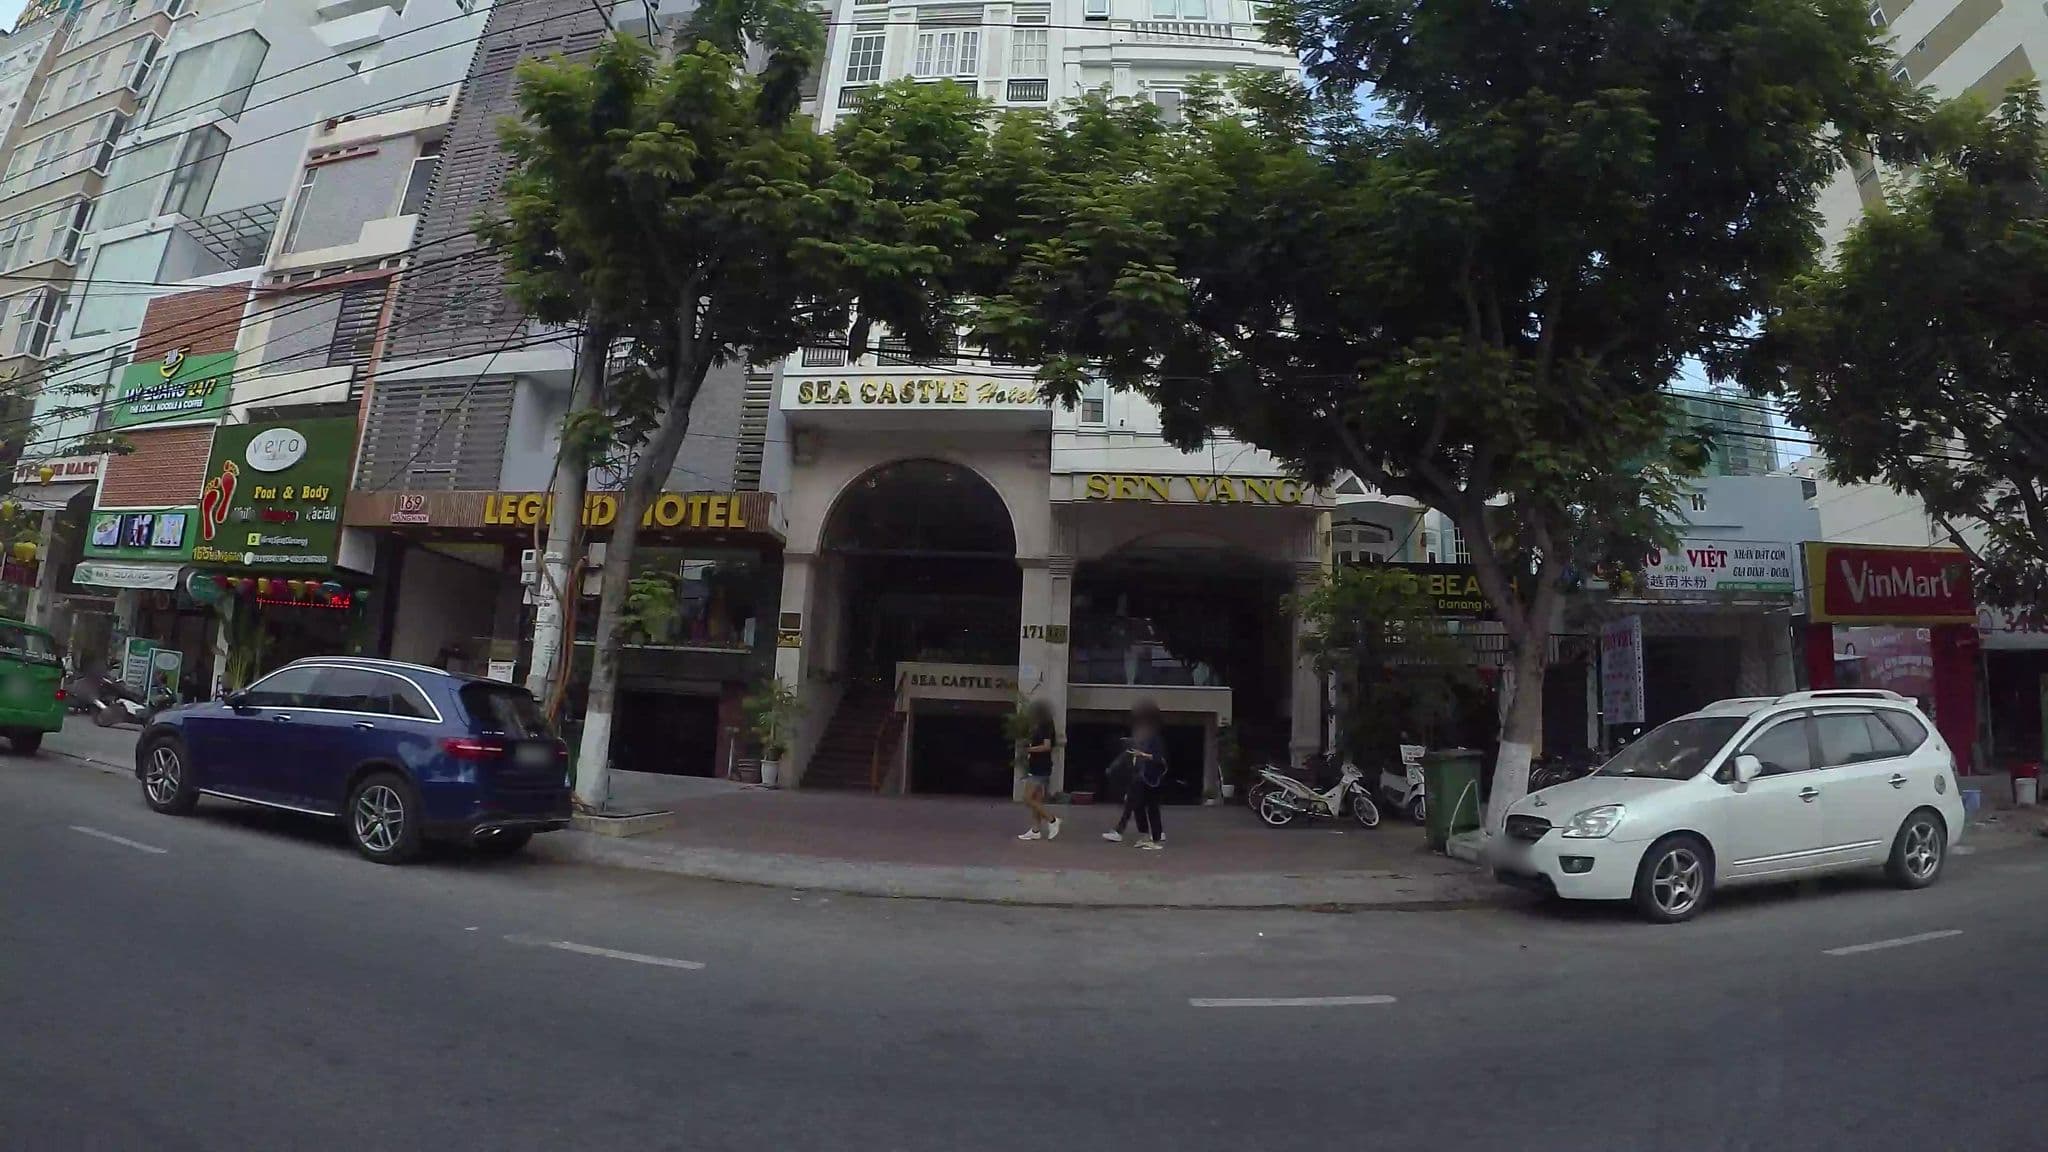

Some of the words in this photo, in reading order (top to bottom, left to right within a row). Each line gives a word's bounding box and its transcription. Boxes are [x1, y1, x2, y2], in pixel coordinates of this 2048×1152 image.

[798, 380, 851, 404] SEA
[860, 379, 969, 404] CASTLE
[139, 403, 156, 413] LOCAL
[183, 399, 203, 409] COFFEE
[254, 486, 276, 499] Foot
[283, 486, 294, 499] &
[302, 485, 329, 501] Body
[1085, 474, 1172, 502] SEN
[400, 495, 423, 510] 169
[641, 495, 747, 528] OTEL
[1687, 545, 1728, 573] VIỆT
[1429, 574, 1518, 597] BEAH
[1840, 559, 1951, 603] VinMart
[1438, 599, 1481, 612] Danang
[1021, 625, 1044, 639] 171
[911, 674, 937, 687] SEA
[941, 675, 993, 689] CASTLE
